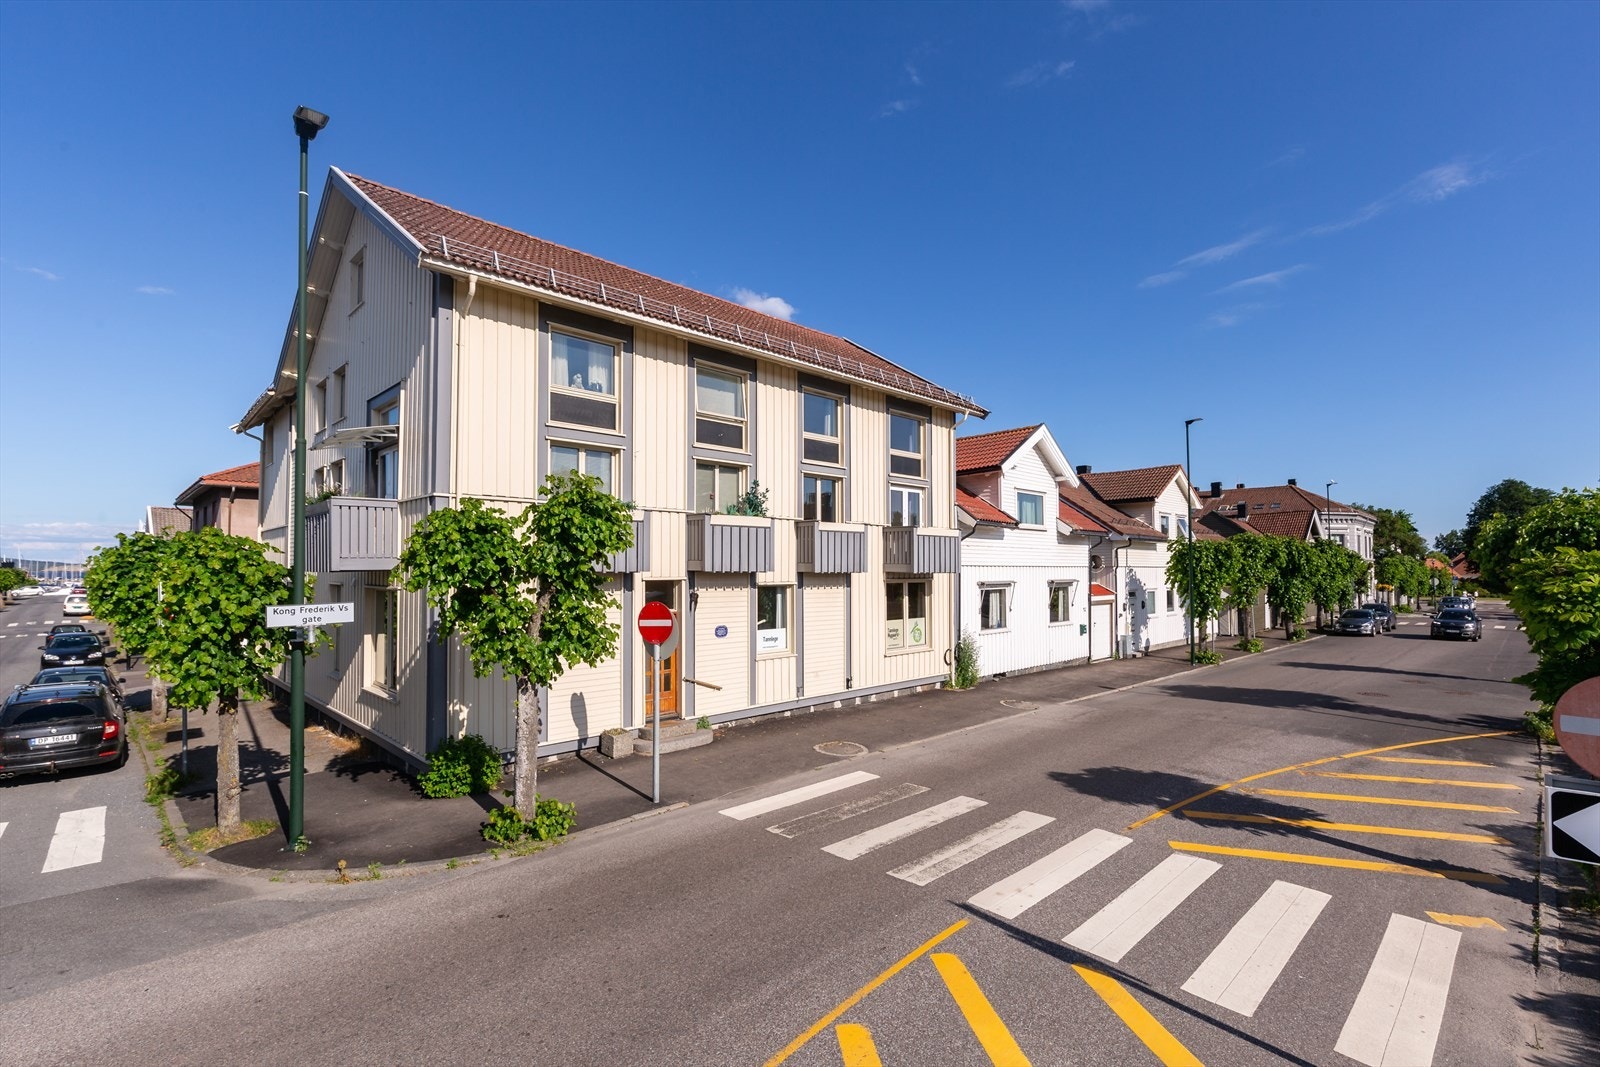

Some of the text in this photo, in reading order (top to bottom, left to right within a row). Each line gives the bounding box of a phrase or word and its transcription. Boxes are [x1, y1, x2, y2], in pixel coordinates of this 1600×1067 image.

[273, 604, 349, 616] Kong Frederik Vs
[302, 615, 322, 624] gate
